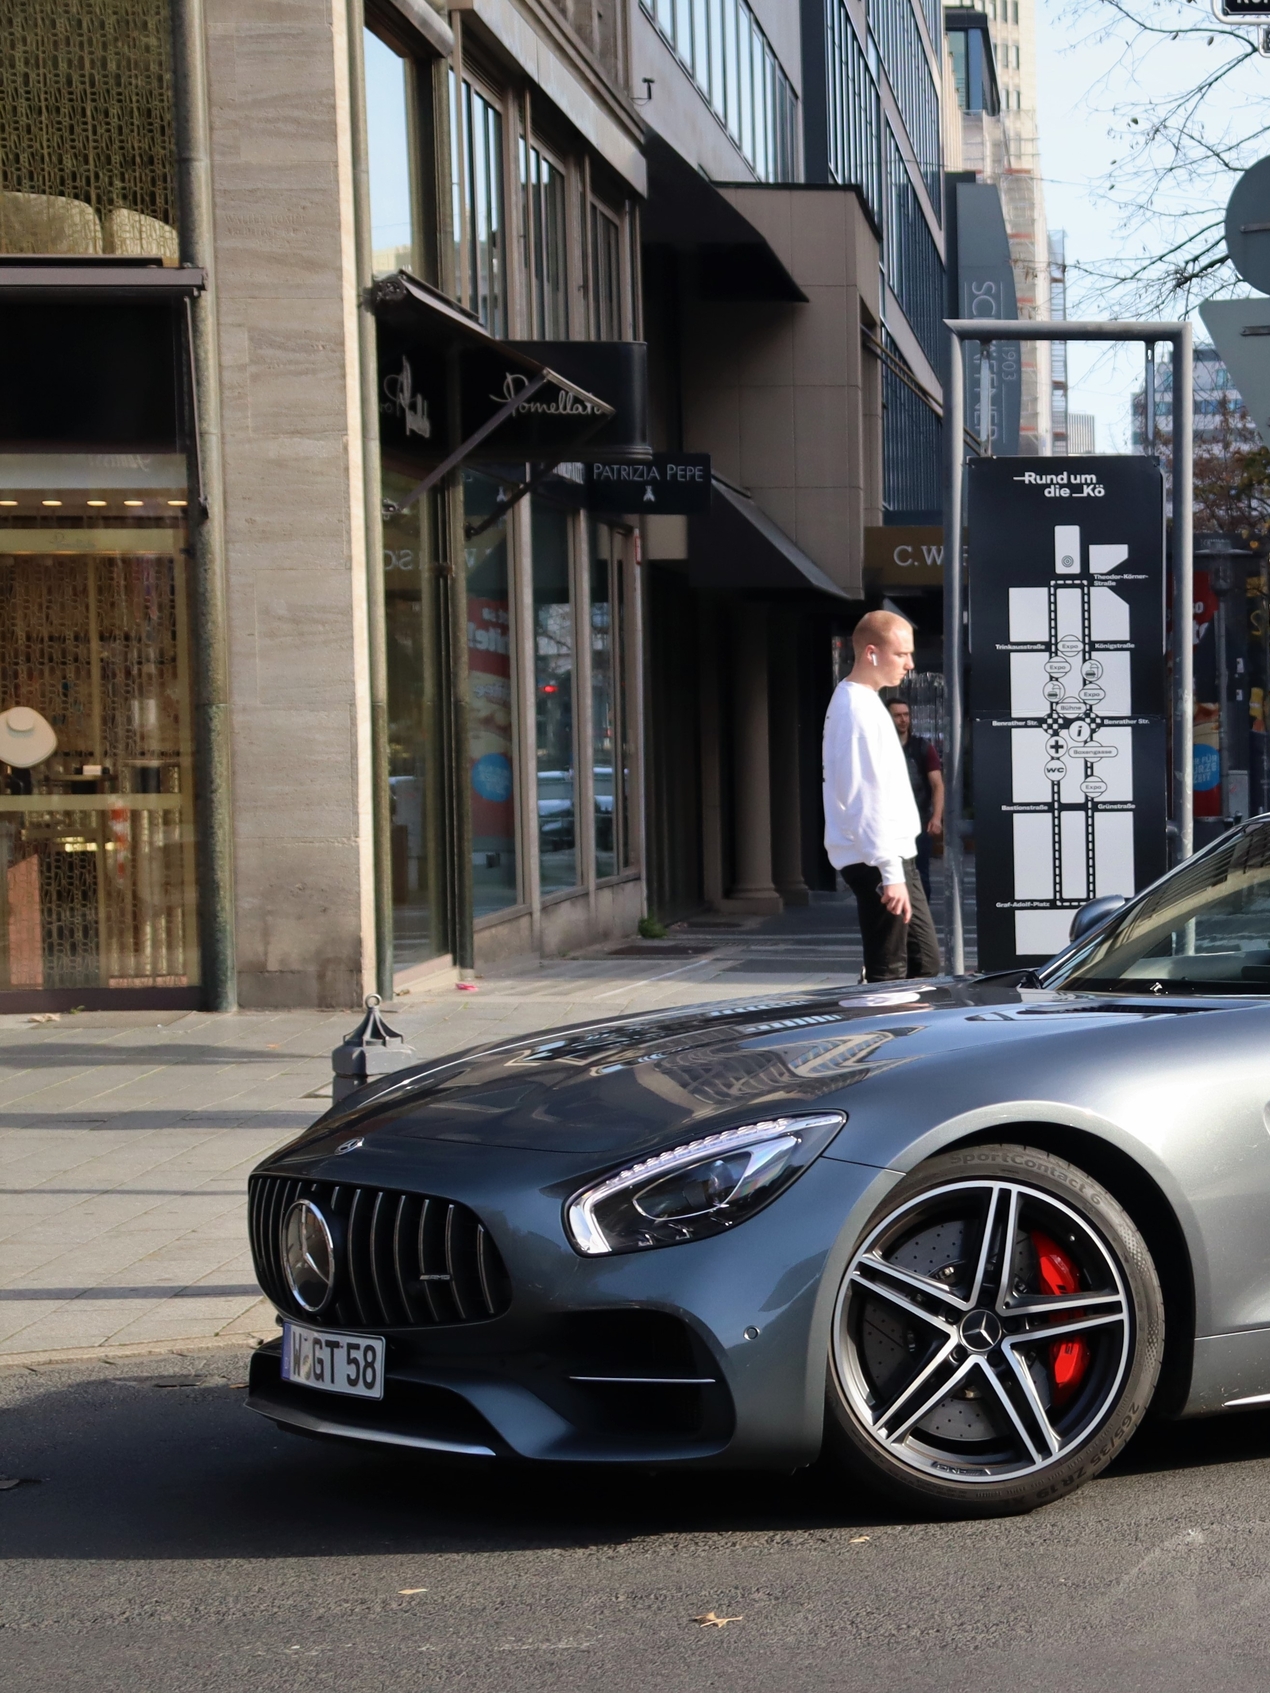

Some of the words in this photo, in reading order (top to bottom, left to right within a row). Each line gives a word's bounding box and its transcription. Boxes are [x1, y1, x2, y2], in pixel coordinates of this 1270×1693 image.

[1001, 347, 1017, 381] 1903
[593, 463, 661, 481] PATRIZIA
[666, 463, 704, 482] PEPE
[1070, 473, 1097, 484] um
[1044, 485, 1071, 497] die
[1083, 691, 1101, 699] Expo
[312, 1337, 341, 1385] GT
[346, 1342, 377, 1390] 58
